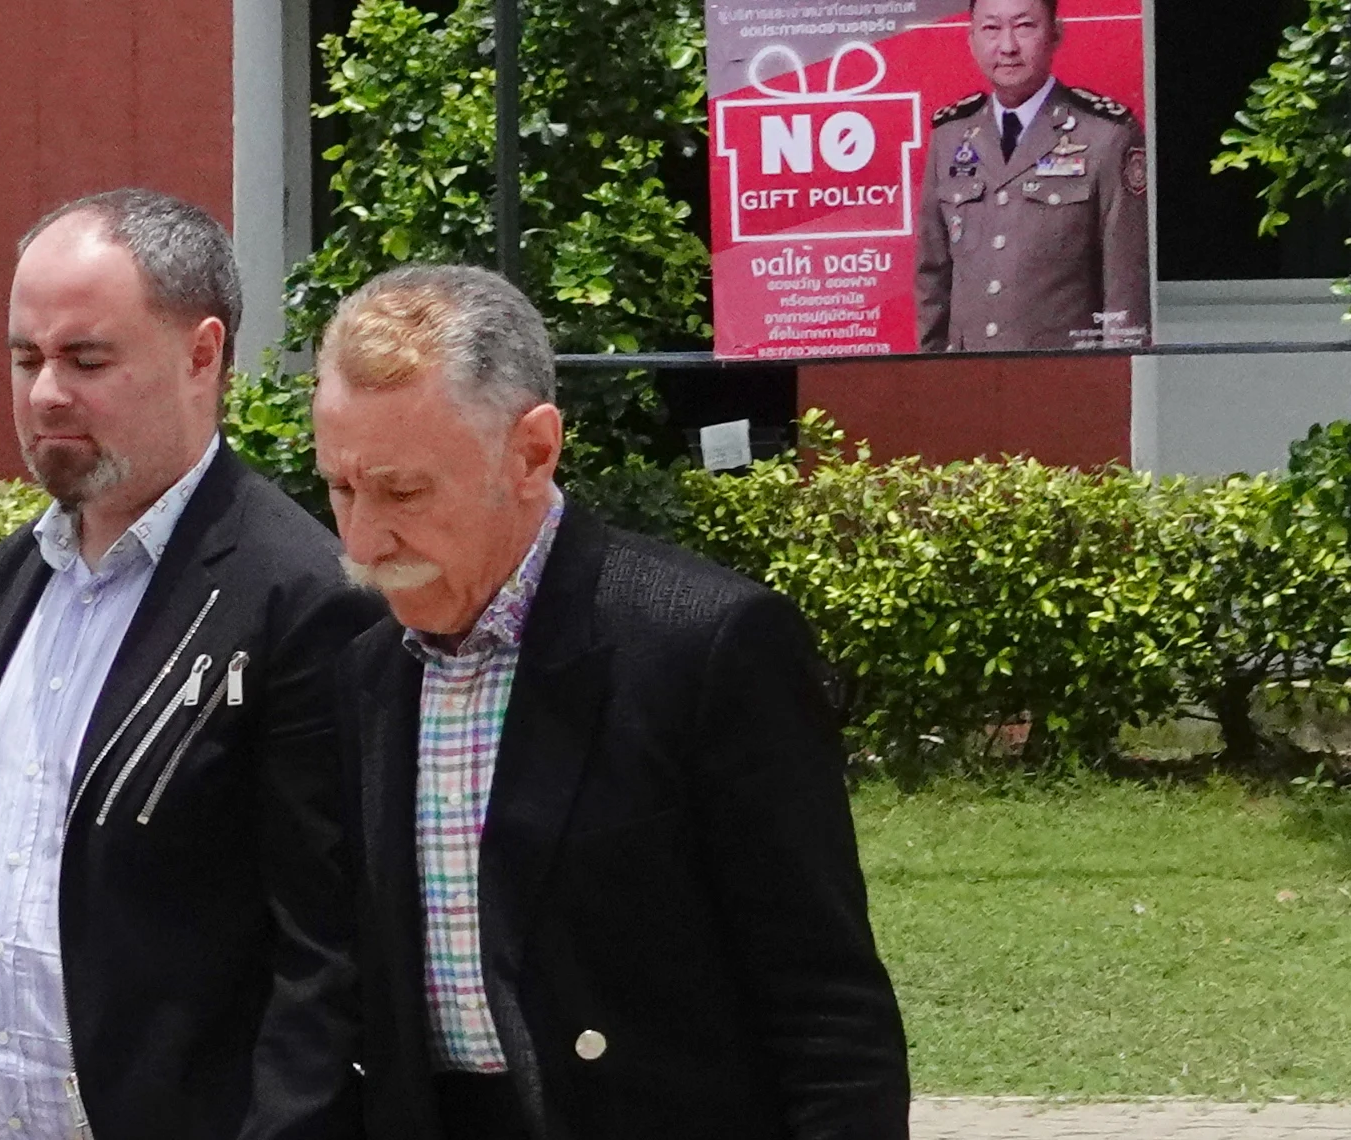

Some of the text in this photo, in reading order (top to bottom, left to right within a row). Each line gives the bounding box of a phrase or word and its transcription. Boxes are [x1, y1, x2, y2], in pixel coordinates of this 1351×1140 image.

[760, 110, 876, 175] NO
[740, 183, 900, 211] GIFT POLICY
[751, 245, 893, 278] งดให้ งดรับ
